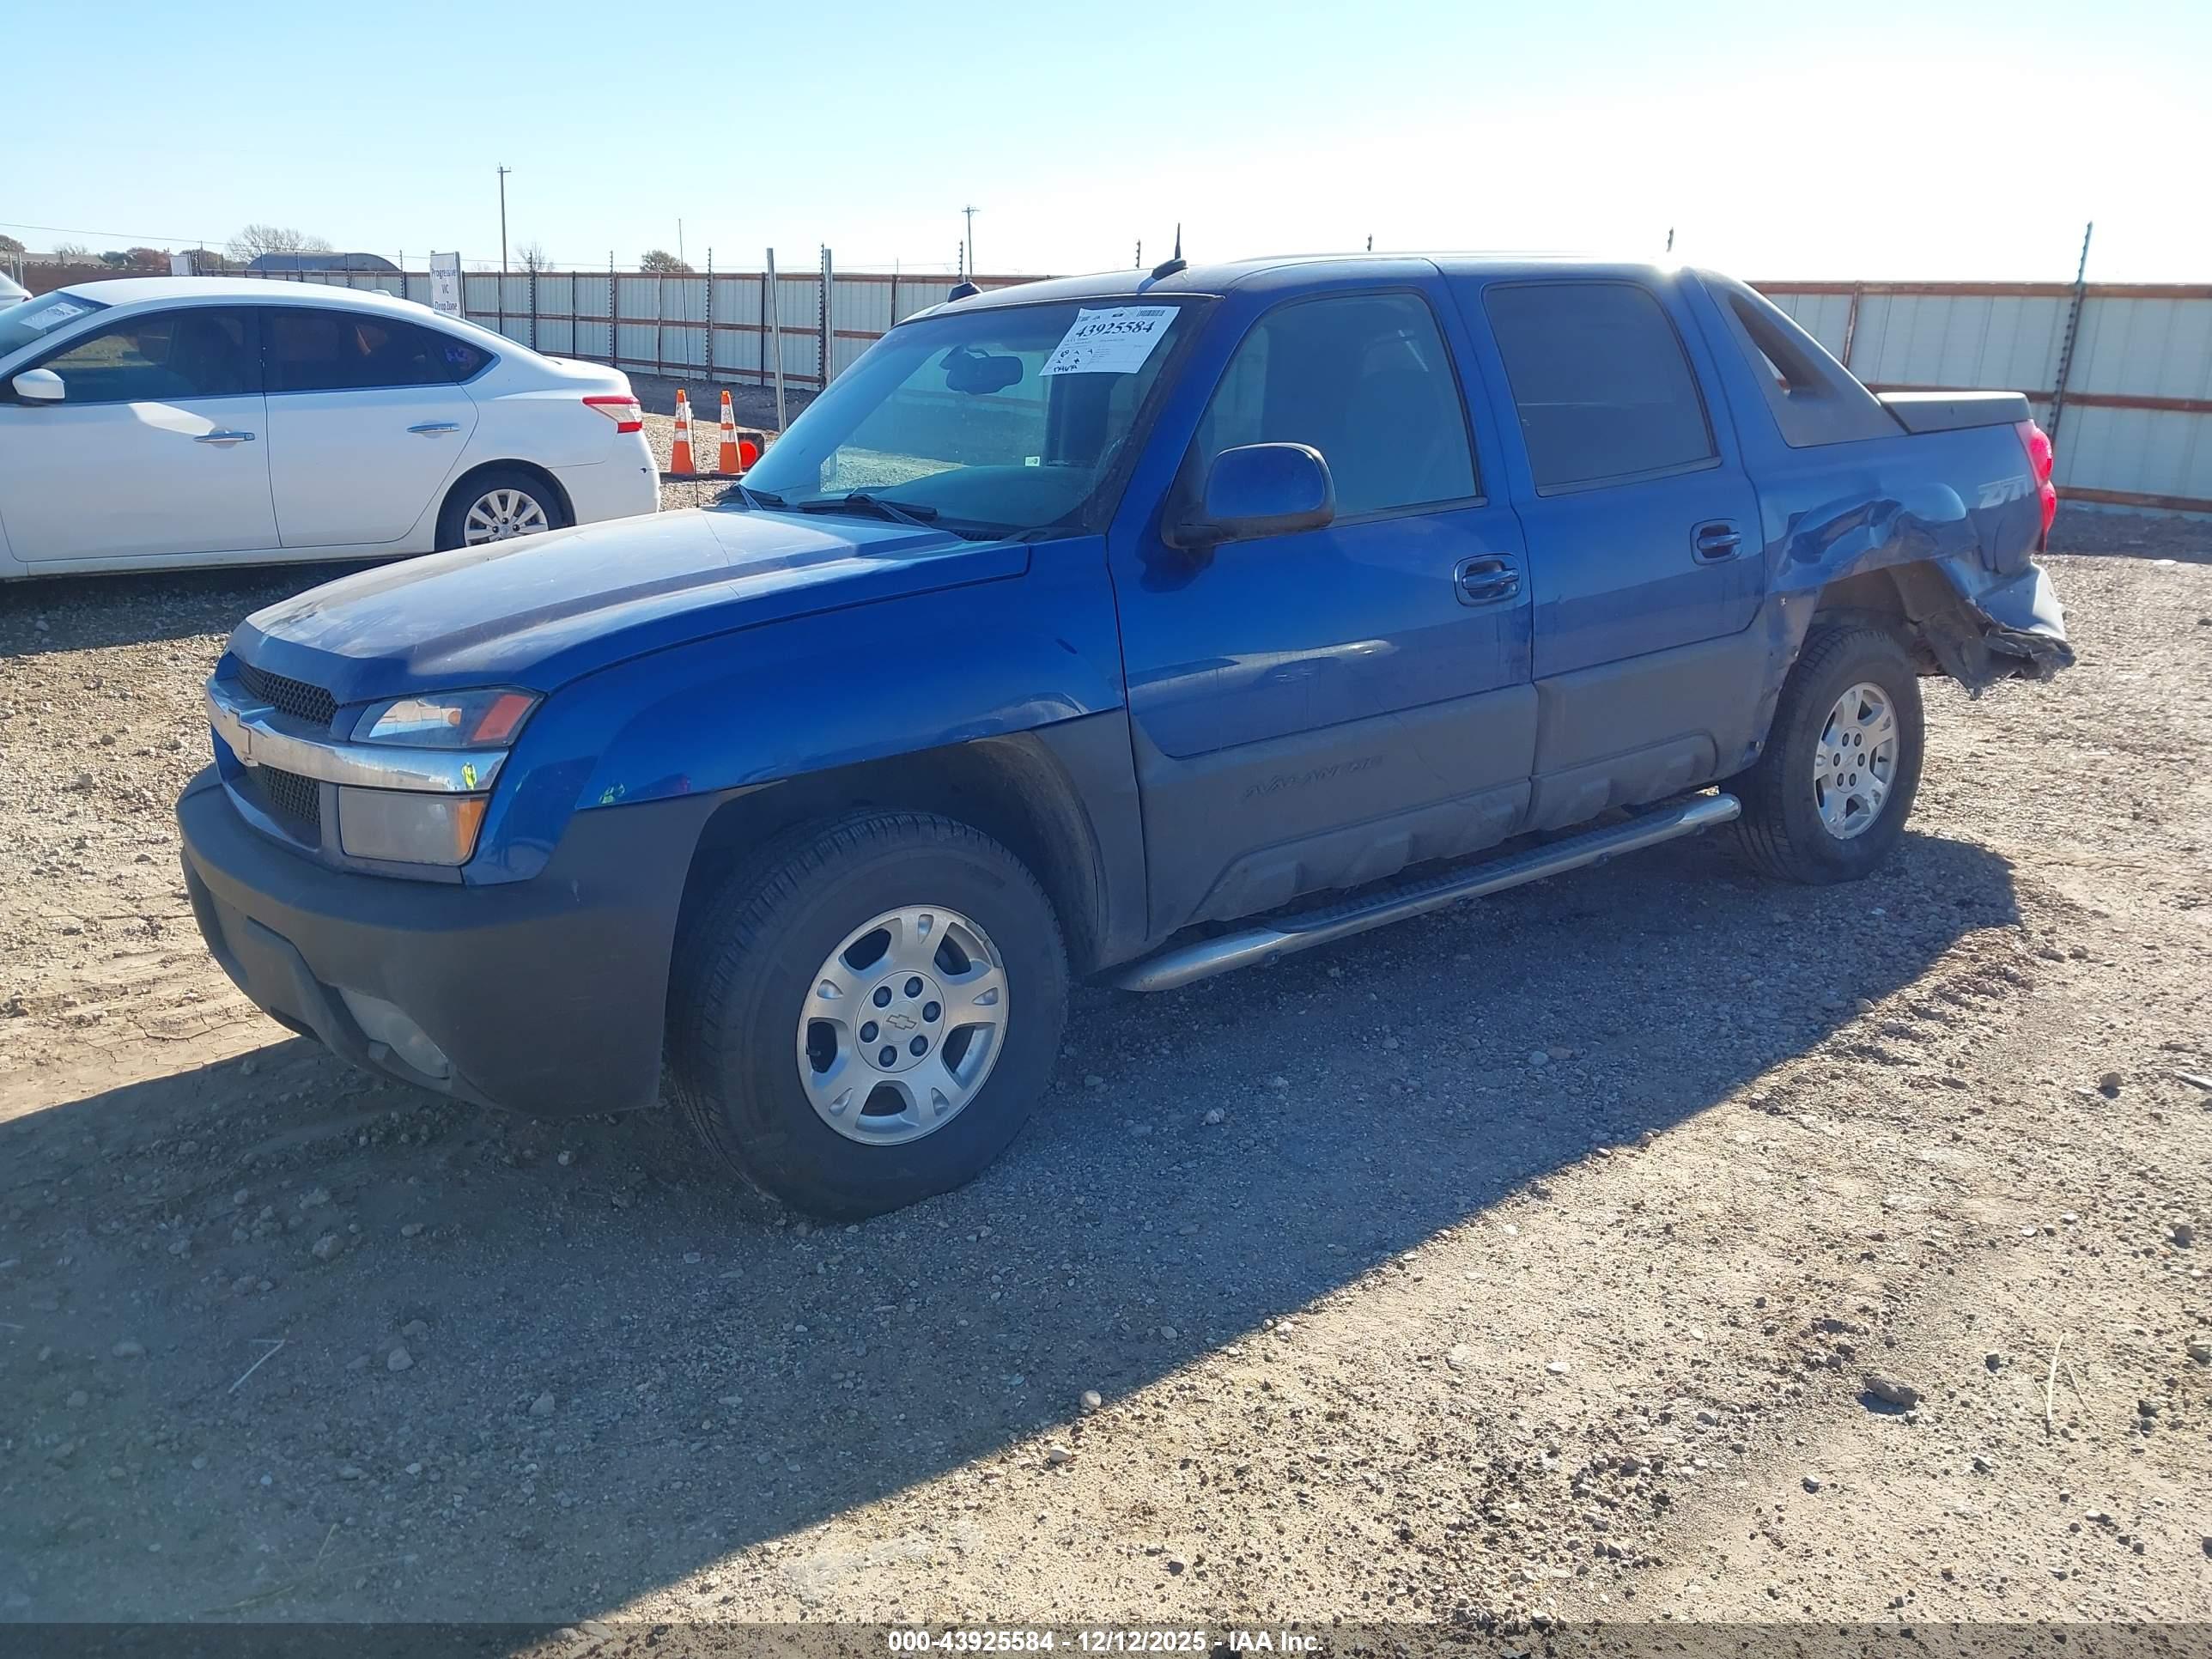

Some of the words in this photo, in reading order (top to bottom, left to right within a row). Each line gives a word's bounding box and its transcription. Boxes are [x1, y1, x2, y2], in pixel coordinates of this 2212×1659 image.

[431, 268, 457, 279] Progressive
[447, 301, 458, 310] Zone
[1076, 320, 1156, 337] 43925584
